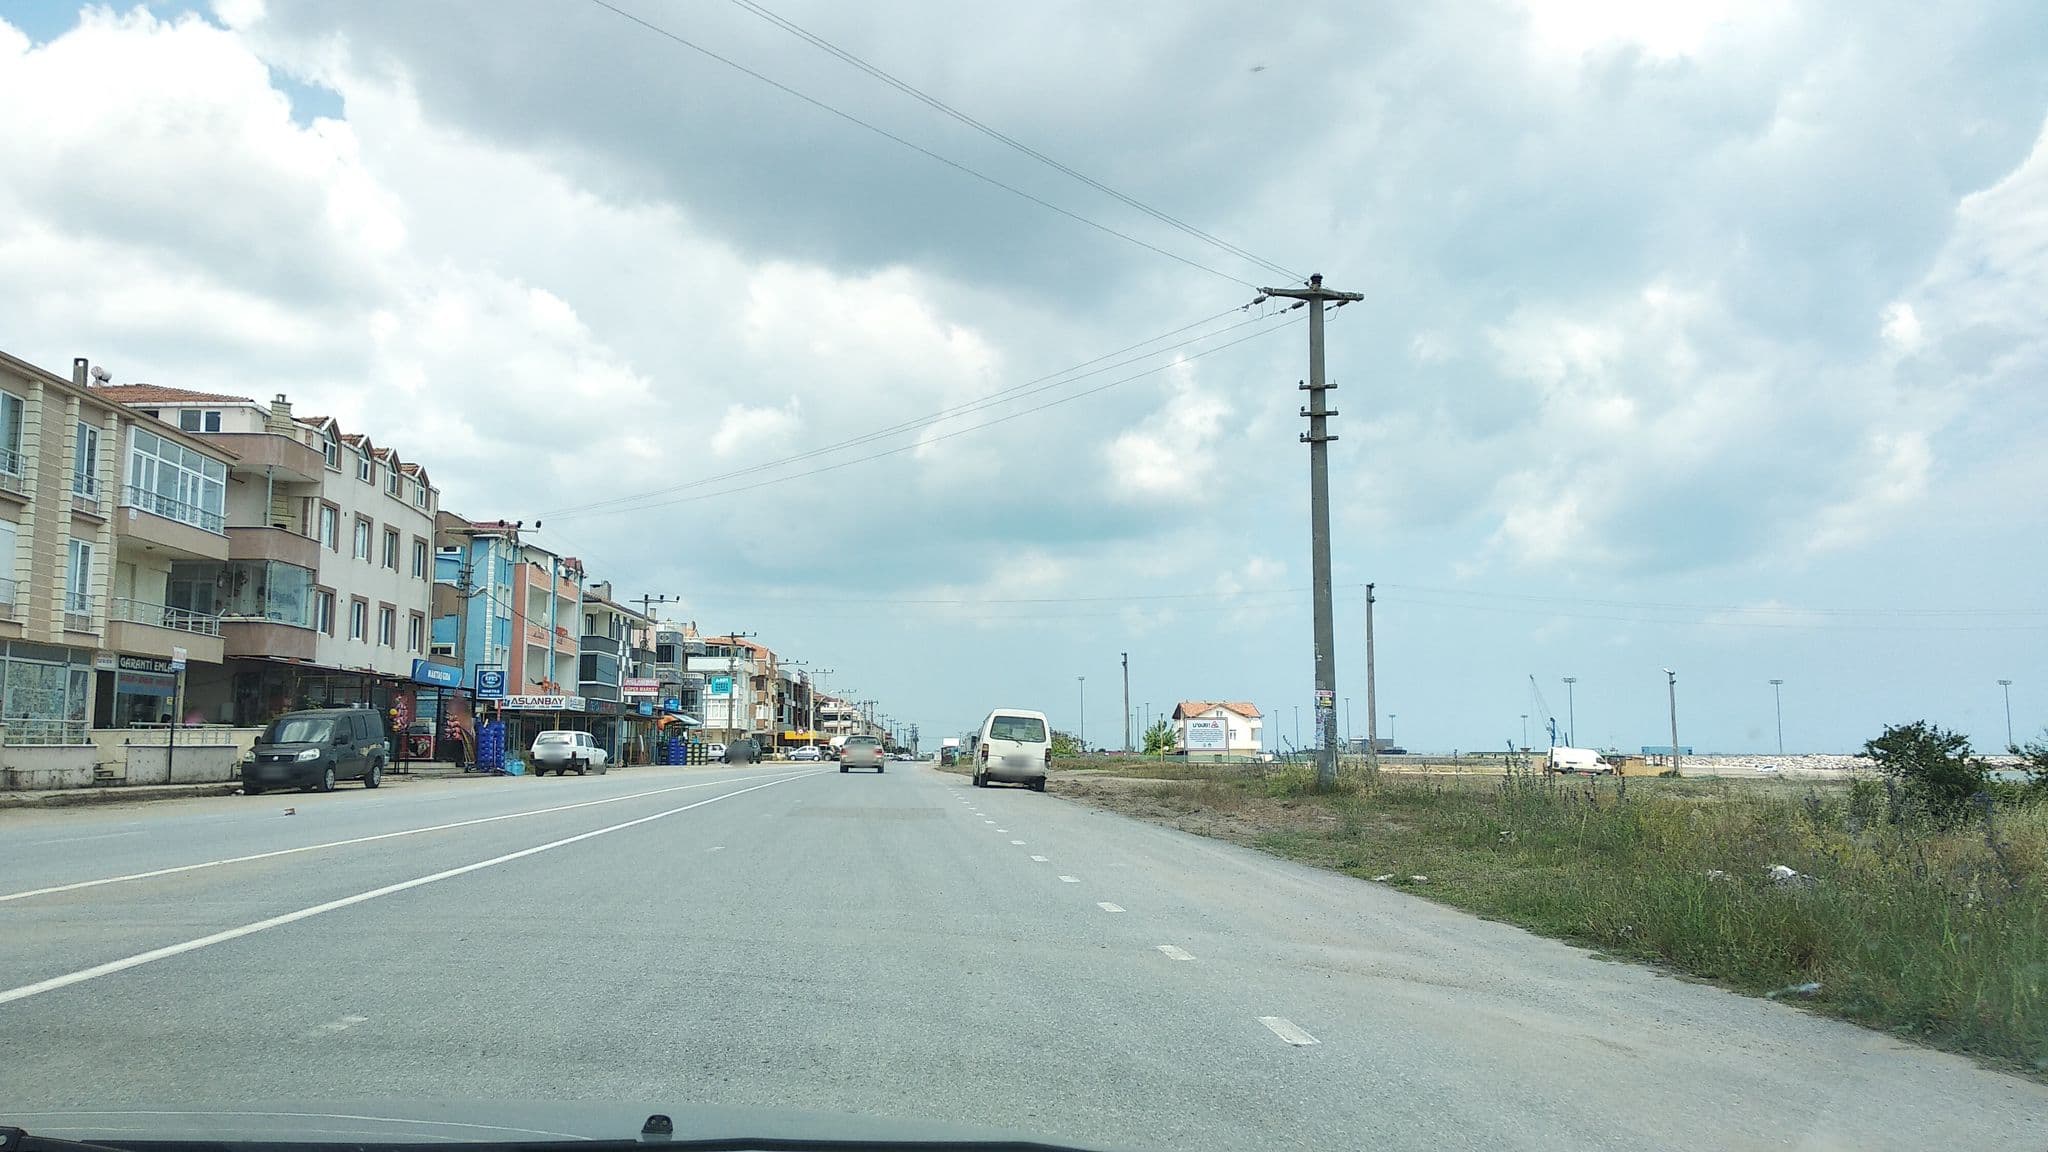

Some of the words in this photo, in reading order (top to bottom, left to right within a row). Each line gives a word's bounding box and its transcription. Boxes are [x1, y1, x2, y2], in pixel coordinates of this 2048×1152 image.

[120, 657, 153, 671] GARANTİ
[154, 661, 173, 673] EMLA
[511, 697, 564, 705] ASLANBAY
